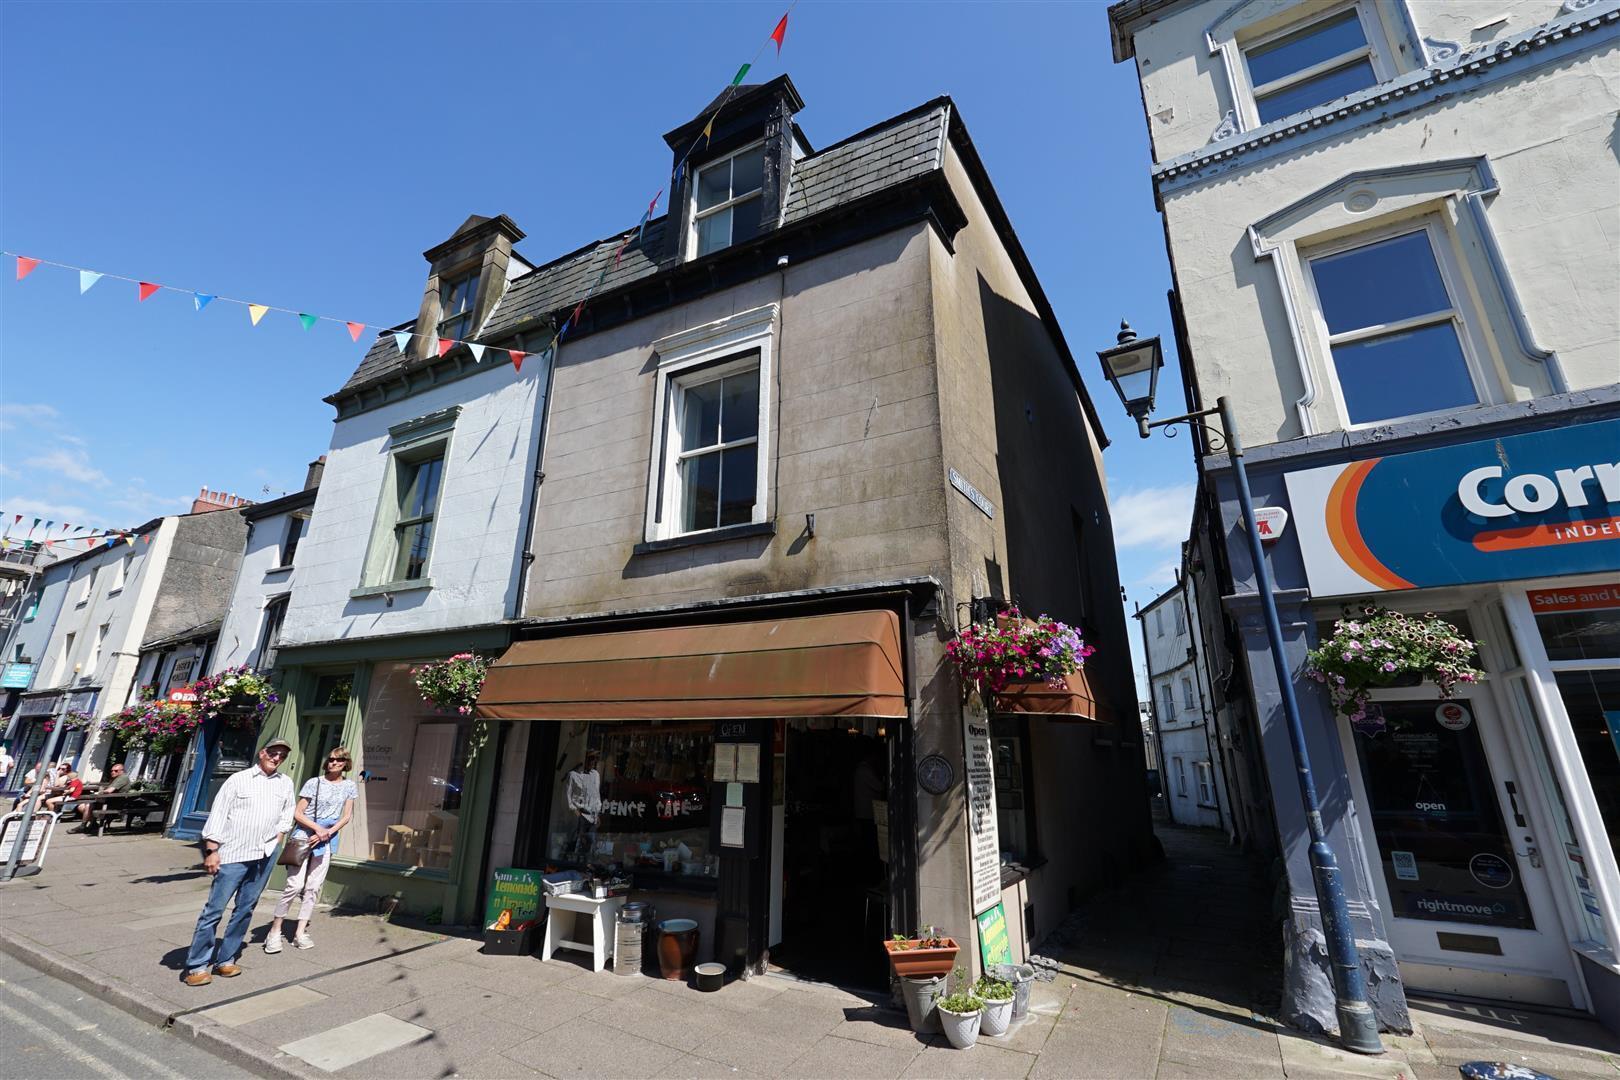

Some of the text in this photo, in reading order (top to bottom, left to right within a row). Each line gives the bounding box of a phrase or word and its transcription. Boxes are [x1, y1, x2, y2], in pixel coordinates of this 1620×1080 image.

[1534, 593, 1577, 606] Sales
[1580, 588, 1611, 602] and
[968, 724, 987, 736] Open
[600, 799, 646, 818] PENCE
[1415, 801, 1446, 812] open
[495, 880, 538, 896] Lemonade
[1417, 898, 1493, 915] rightmove
